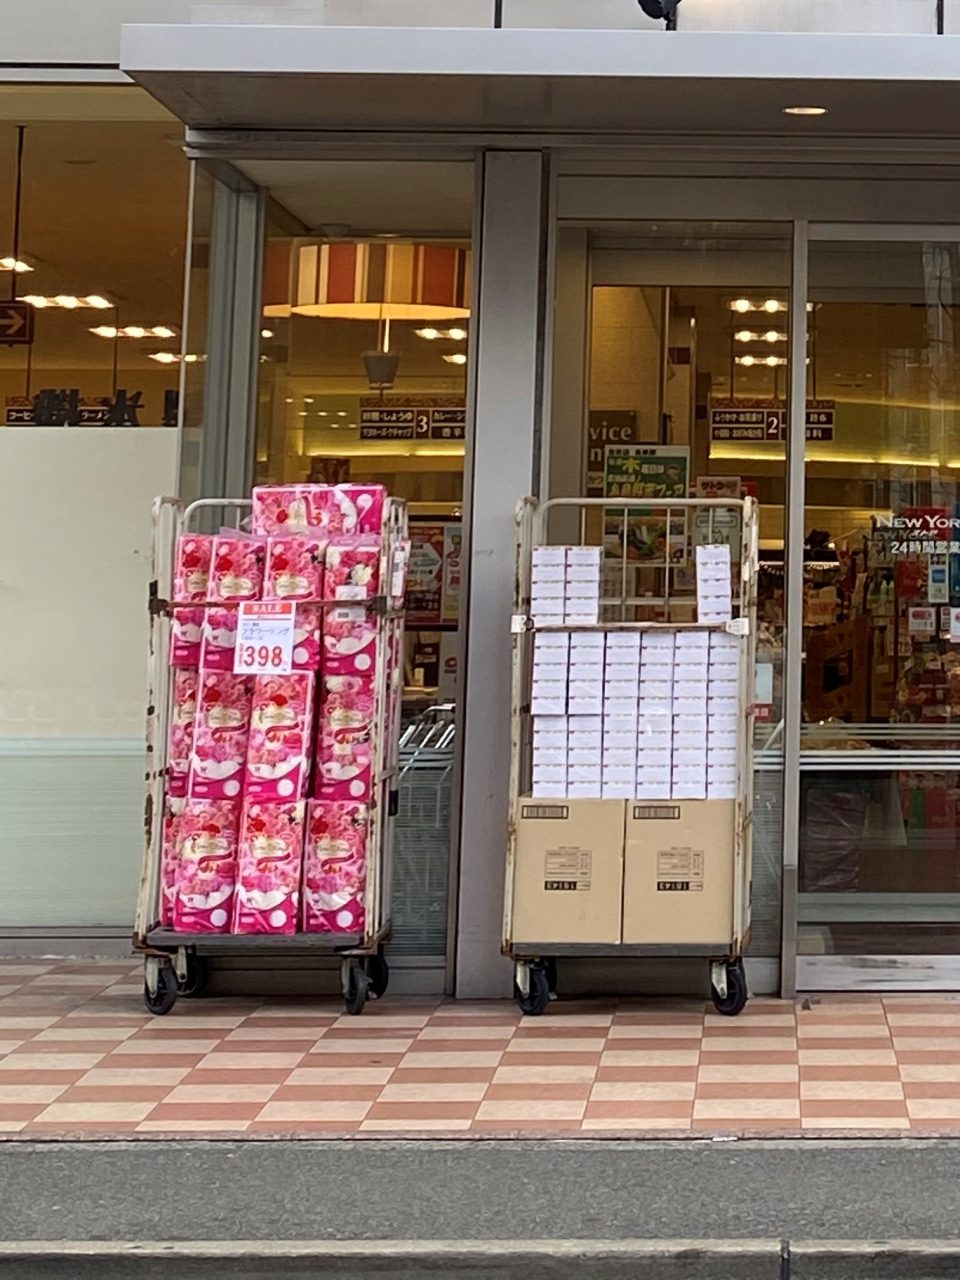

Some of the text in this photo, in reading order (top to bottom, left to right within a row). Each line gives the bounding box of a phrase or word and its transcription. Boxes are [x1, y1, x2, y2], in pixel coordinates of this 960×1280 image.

[417, 415, 428, 433] 3
[767, 416, 778, 434] 2
[890, 541, 960, 554] 24時間営業
[244, 646, 282, 667] 398
